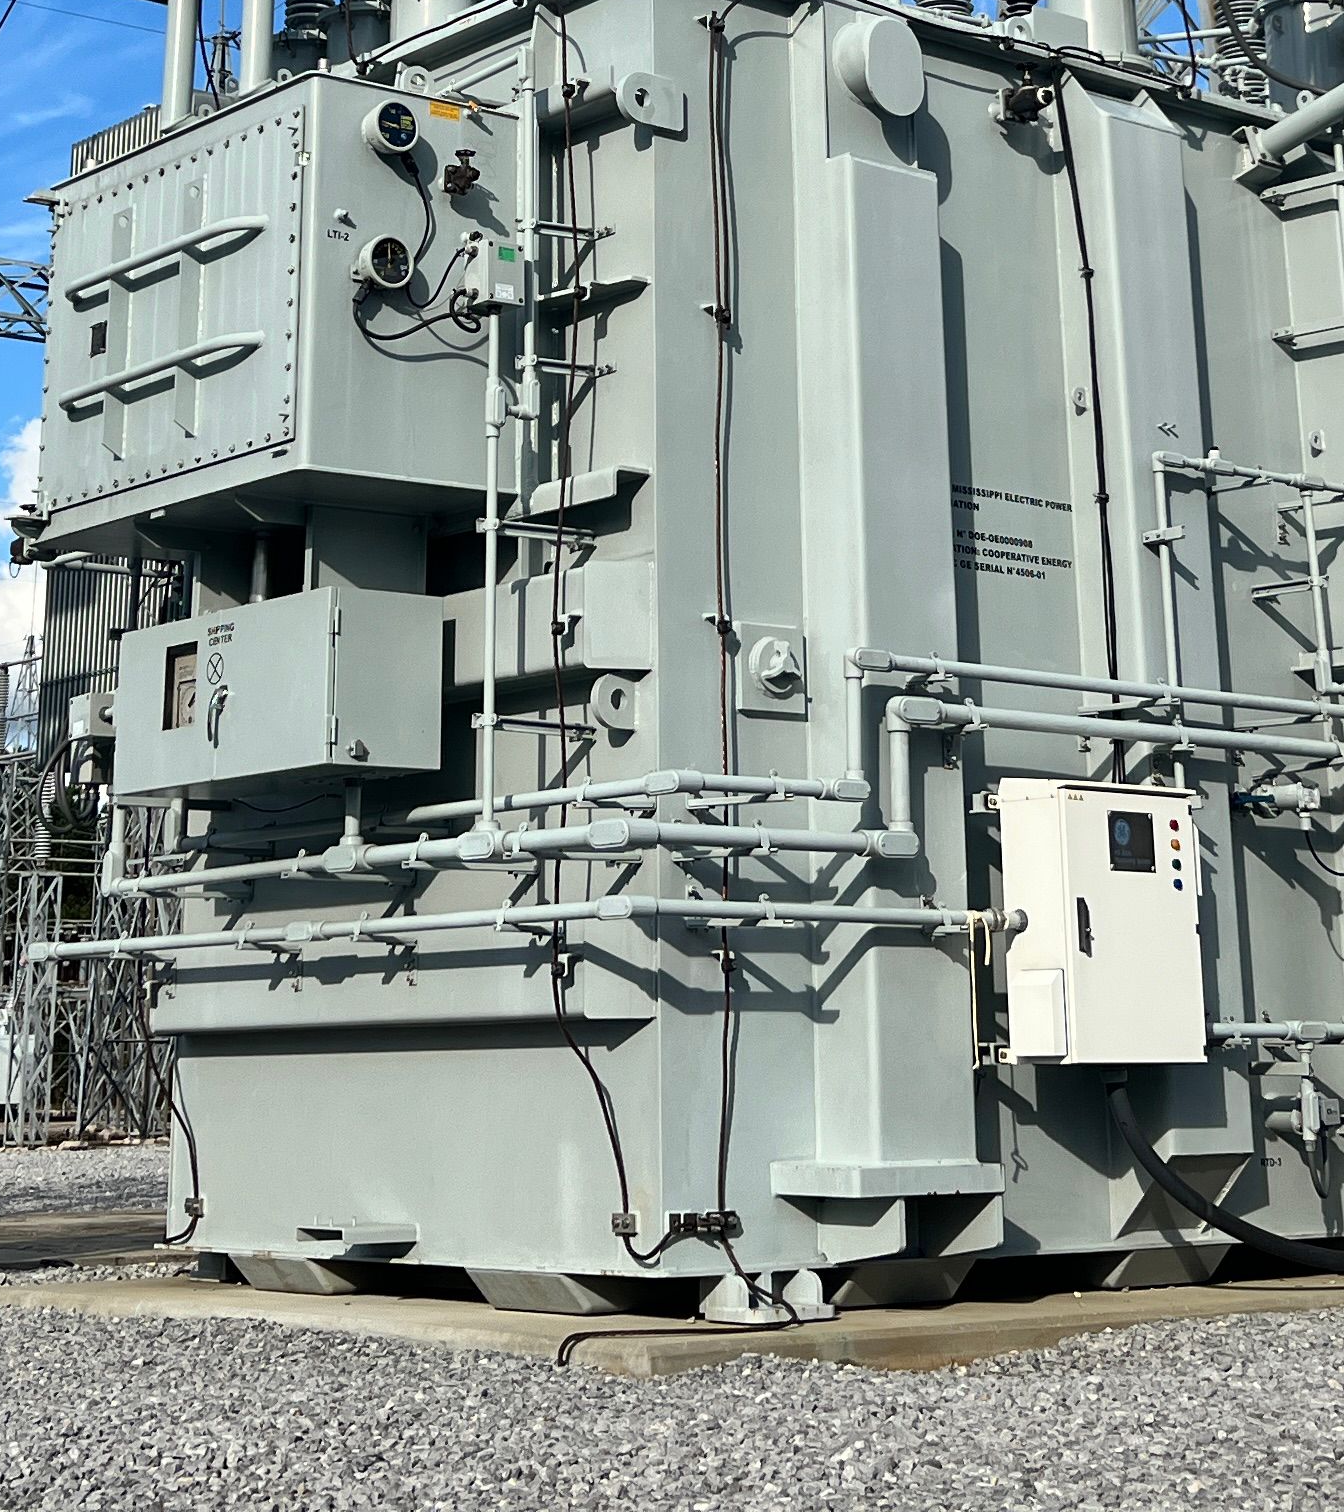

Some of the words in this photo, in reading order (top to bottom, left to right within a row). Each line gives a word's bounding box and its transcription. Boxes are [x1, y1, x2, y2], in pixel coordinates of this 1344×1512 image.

[327, 229, 350, 241] LTI-2
[952, 484, 1002, 500] MISSISSIPPI
[1005, 493, 1043, 507] ELECTRIC
[1045, 500, 1072, 512] POWER
[982, 548, 1039, 564] COOPERATIVE
[1041, 557, 1072, 568] ENERGY
[960, 560, 972, 569] GE
[974, 561, 1004, 574] SERIAL
[208, 634, 233, 646] CENTER
